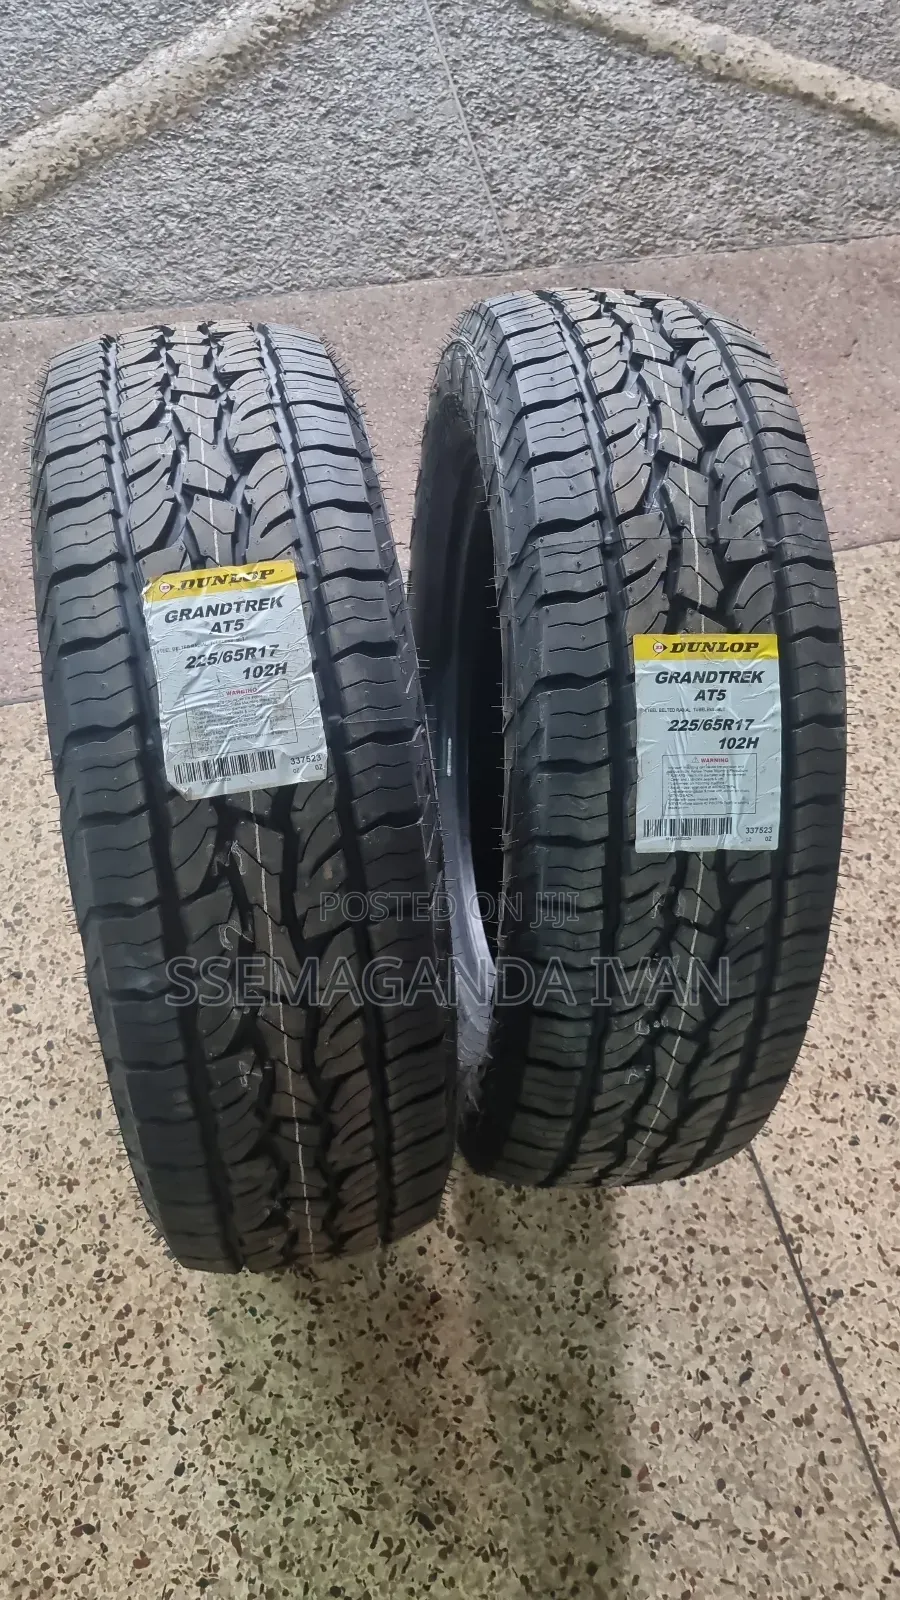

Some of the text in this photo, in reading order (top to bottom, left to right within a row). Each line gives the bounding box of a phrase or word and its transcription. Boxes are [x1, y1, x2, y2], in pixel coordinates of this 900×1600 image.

[179, 569, 275, 590] DUNLOP
[165, 595, 284, 623] GRANDTREK
[210, 618, 245, 634] AT5
[670, 642, 759, 653] DUNLOP
[184, 644, 280, 669] 225/65R17
[243, 662, 288, 680] 102H
[655, 670, 765, 684] GRANDTREK
[694, 688, 727, 701] AT5
[667, 718, 755, 732] 225/65R17
[718, 736, 760, 750] 102H
[290, 754, 322, 766] 337523
[745, 826, 773, 834] 337523
